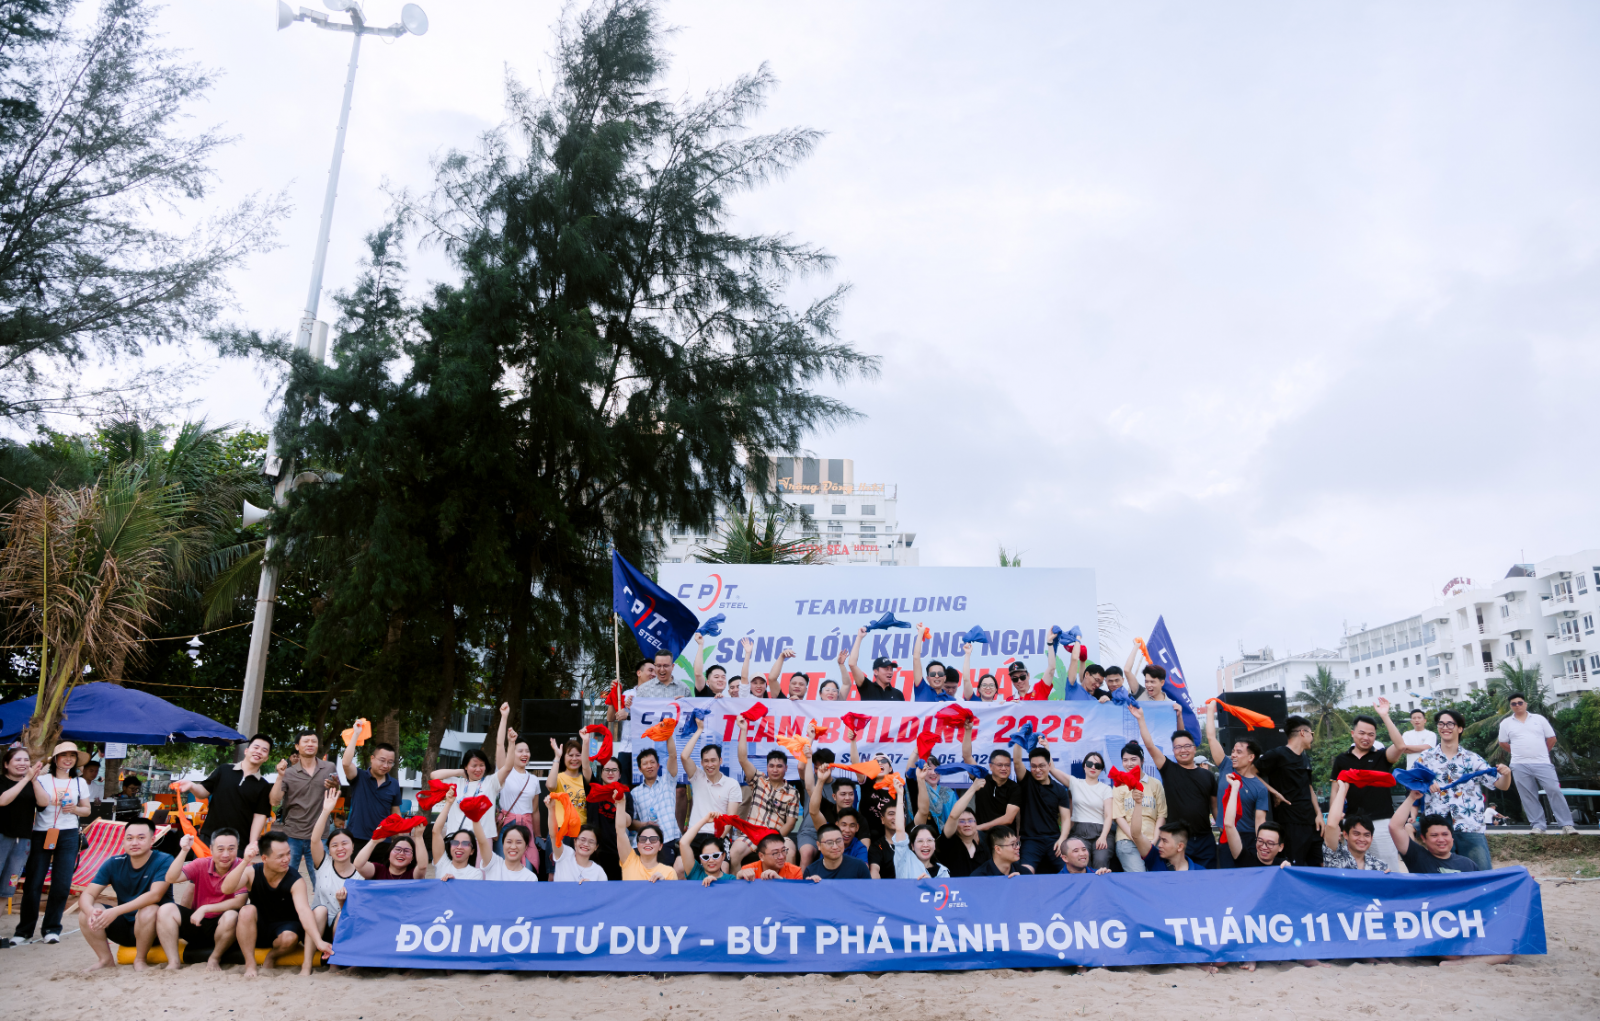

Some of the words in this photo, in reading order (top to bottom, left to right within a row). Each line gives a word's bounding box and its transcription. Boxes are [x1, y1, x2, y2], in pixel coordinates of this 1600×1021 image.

[826, 544, 850, 555] SEA
[795, 595, 967, 615] TEAMBUILDING
[638, 628, 662, 650] STEEL
[716, 629, 793, 663] SÓNG
[981, 629, 1046, 659] NGẠI
[723, 714, 806, 743] TEAM
[818, 716, 980, 743] BUILDING
[993, 714, 1084, 743] 2026
[396, 909, 462, 953] ĐỔI
[470, 916, 541, 954] MỚI
[552, 922, 604, 955] TƯ
[610, 926, 688, 955] DUY
[727, 916, 805, 955] BỨT
[816, 916, 894, 954] PHÁ
[904, 916, 1010, 954] HÀNH
[1018, 913, 1128, 960] ĐỘNG
[1165, 907, 1293, 946] THÁNG
[1301, 912, 1331, 942] 11
[1337, 898, 1387, 941] VỀ
[1393, 902, 1486, 940] ĐÍCH
